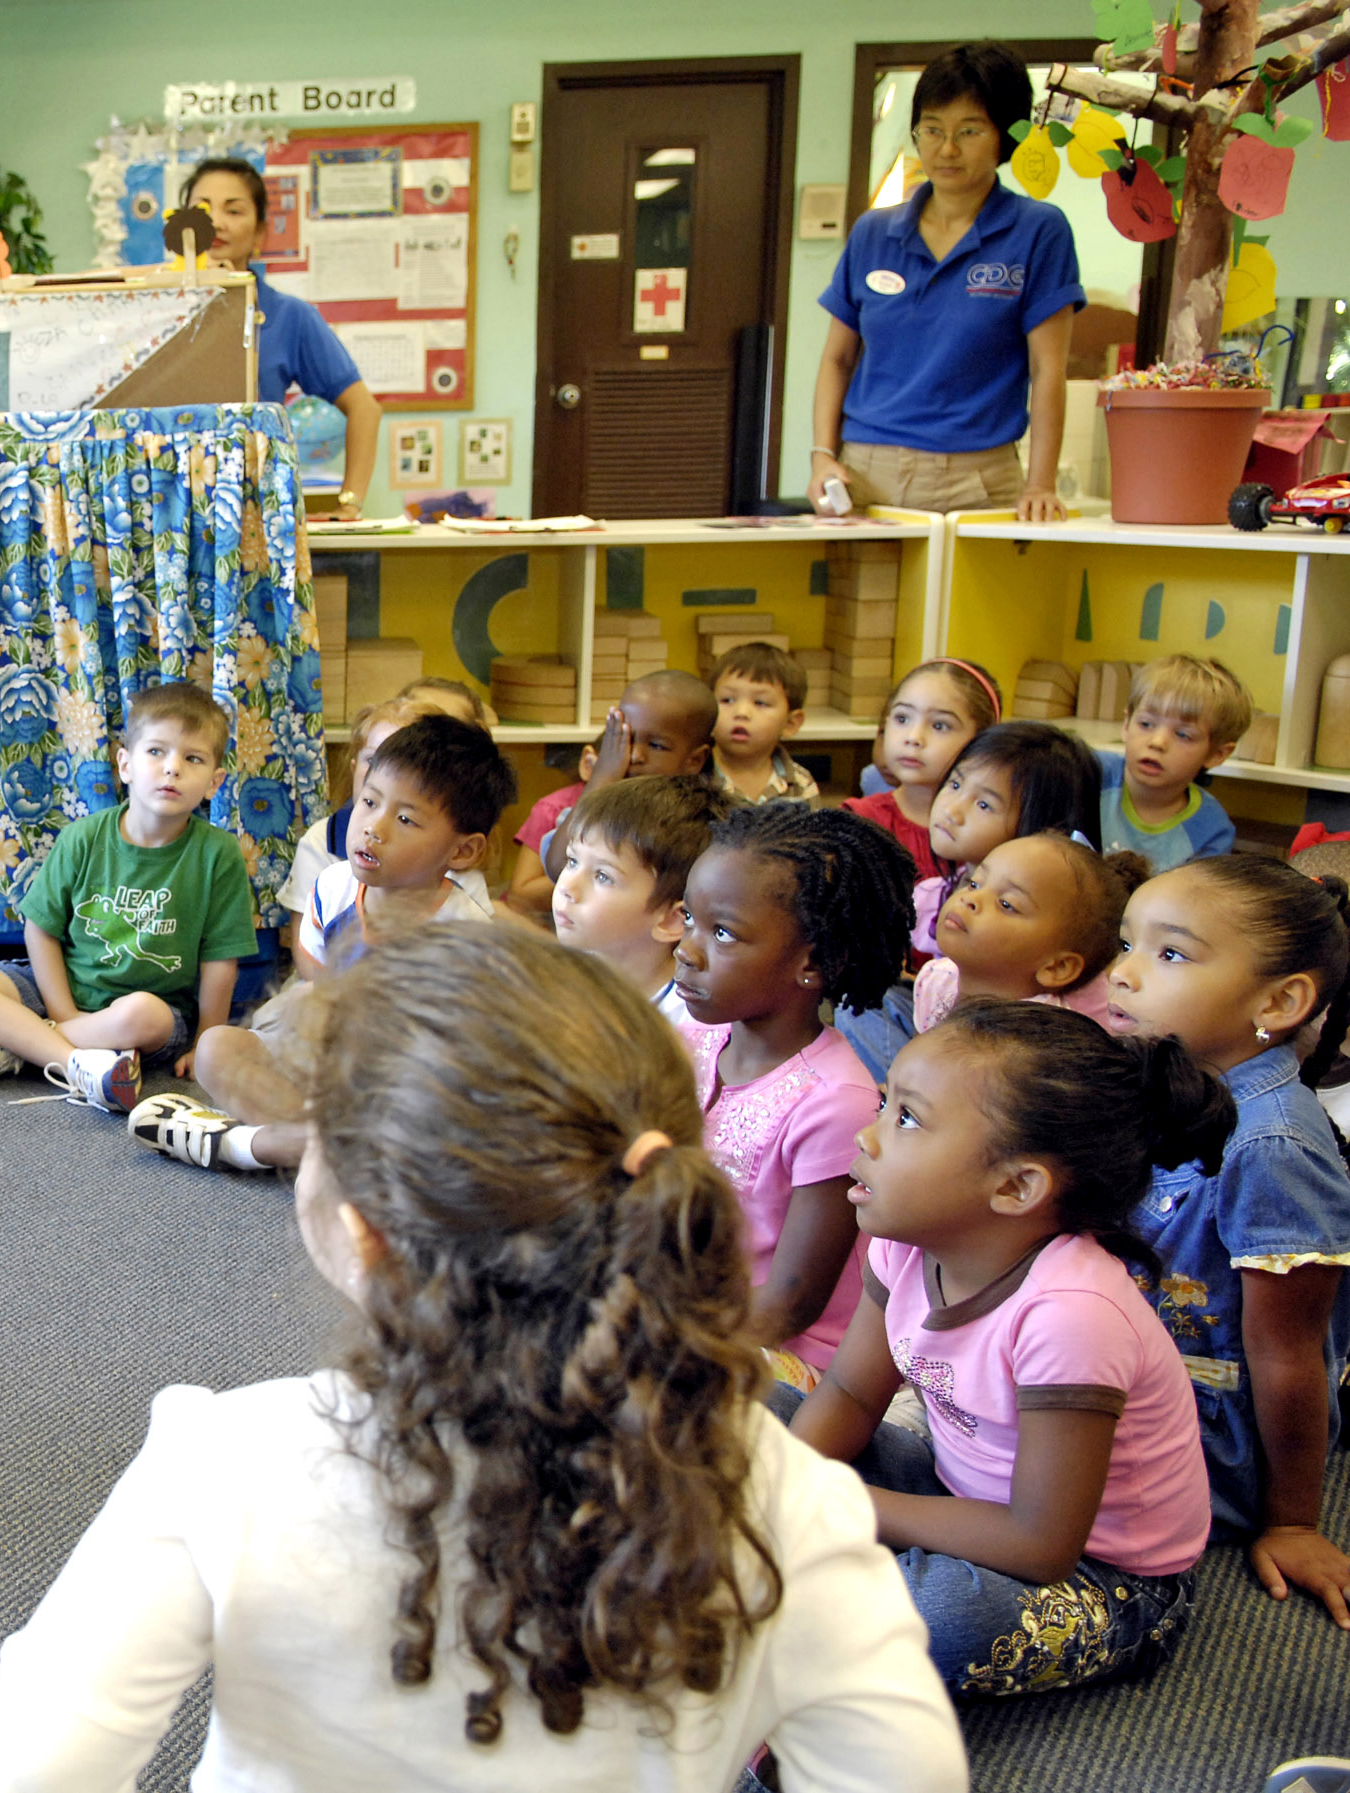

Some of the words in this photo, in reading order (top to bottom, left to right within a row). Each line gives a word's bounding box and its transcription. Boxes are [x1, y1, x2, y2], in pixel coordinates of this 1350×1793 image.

[179, 87, 279, 116] Parent
[302, 83, 398, 112] Board
[115, 886, 172, 912] LEAP
[138, 909, 157, 920] OF
[138, 919, 177, 935] FAITH
